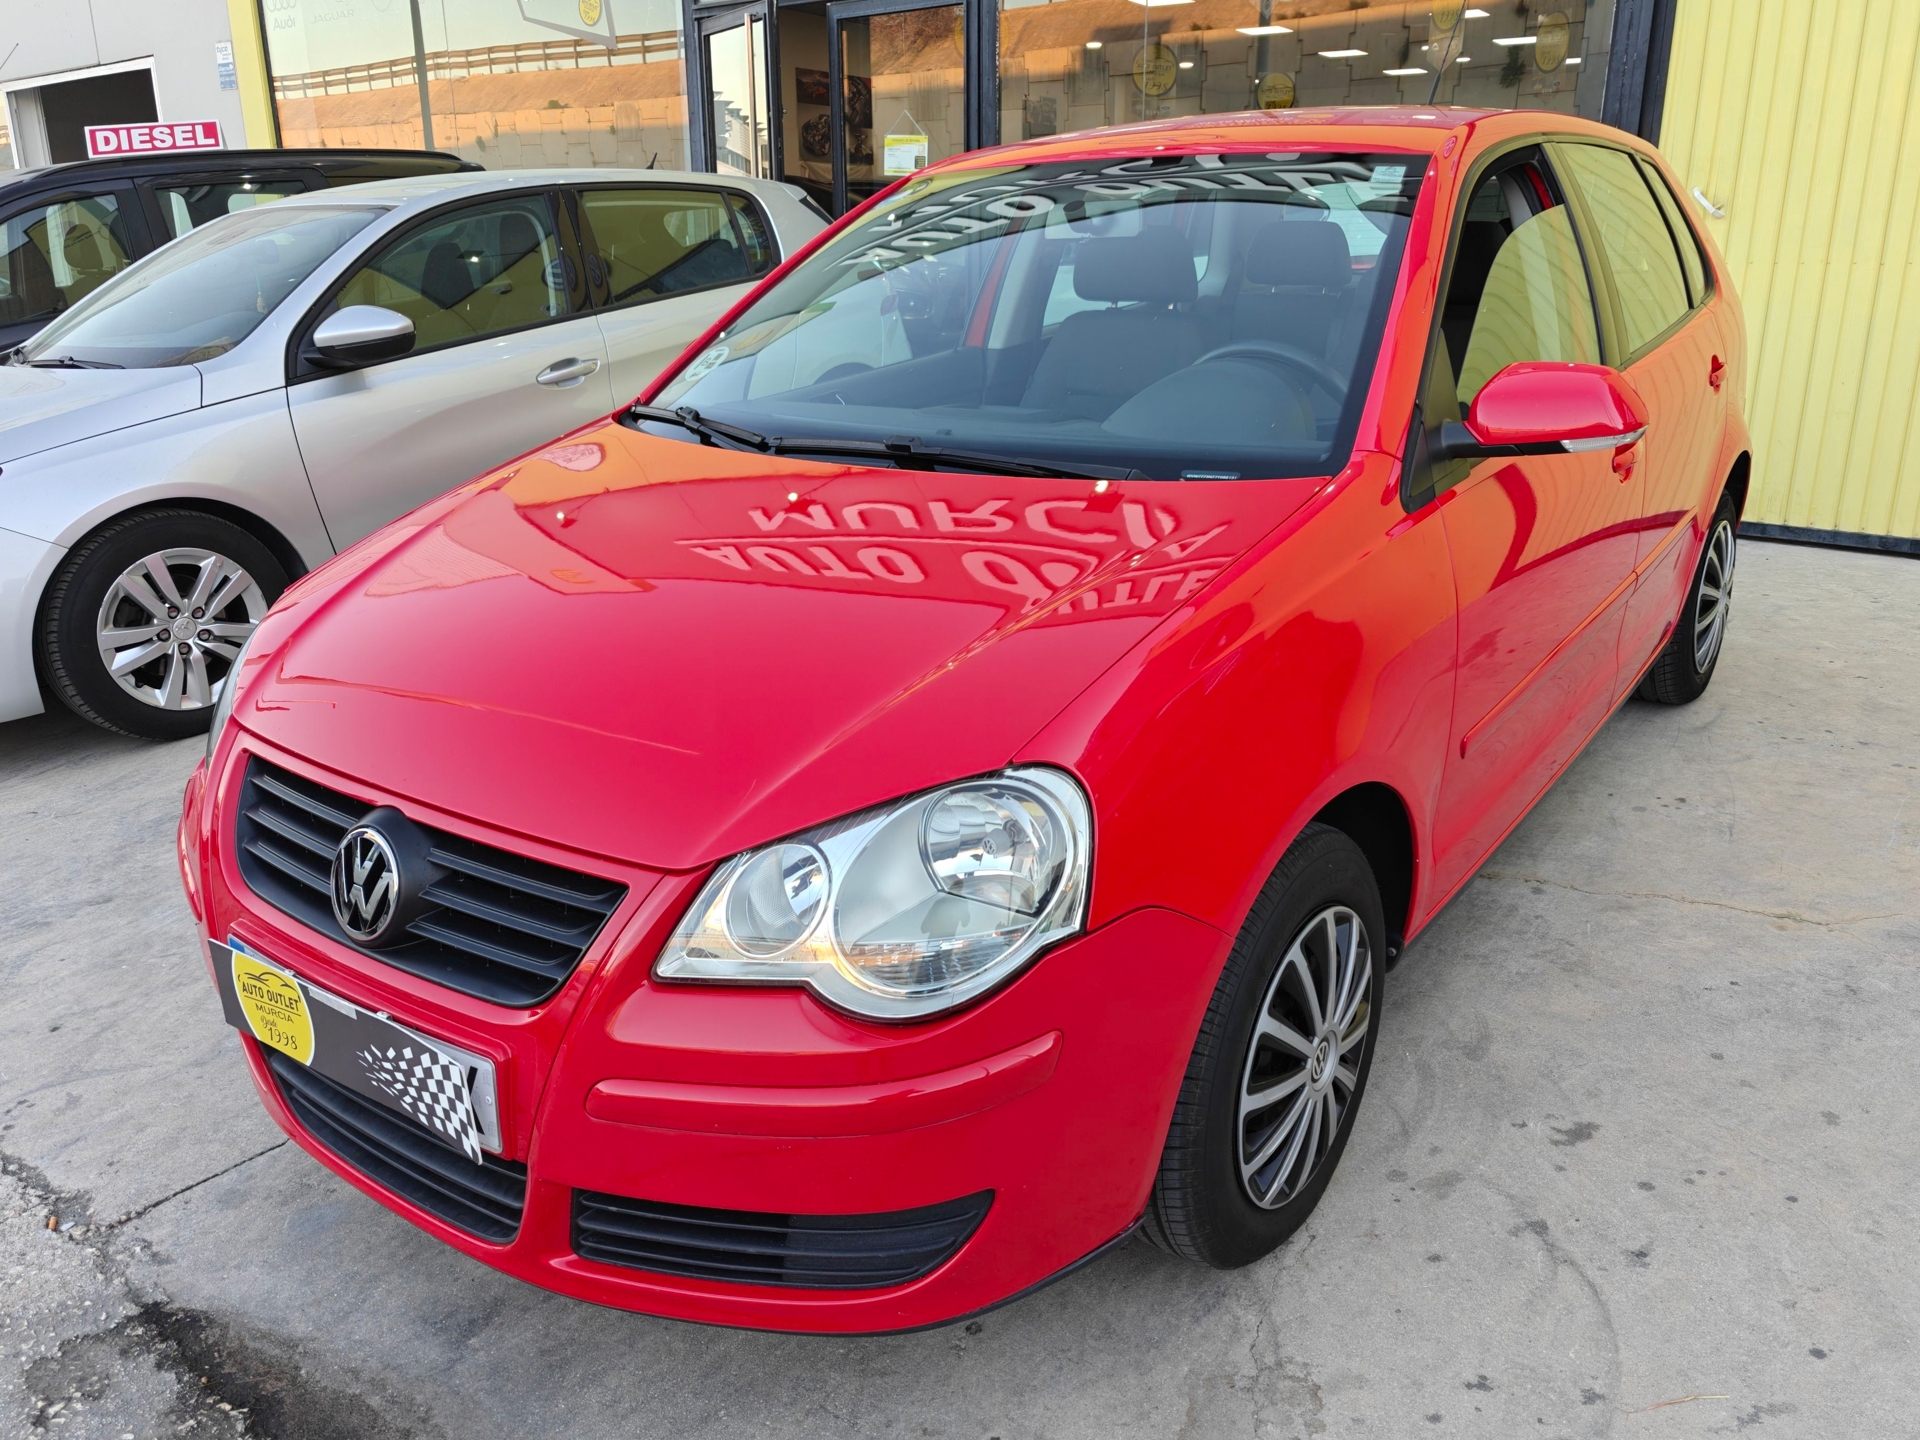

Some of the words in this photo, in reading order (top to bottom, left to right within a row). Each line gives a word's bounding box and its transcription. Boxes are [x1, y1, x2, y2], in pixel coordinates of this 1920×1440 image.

[273, 15, 296, 31] Audi
[310, 8, 355, 25] JAGUAR
[95, 124, 216, 152] DIESEL
[242, 981, 264, 999] AUTO
[266, 989, 299, 1012] OUTLET
[255, 1003, 294, 1024] MURCIA
[267, 1026, 299, 1050] 1998
